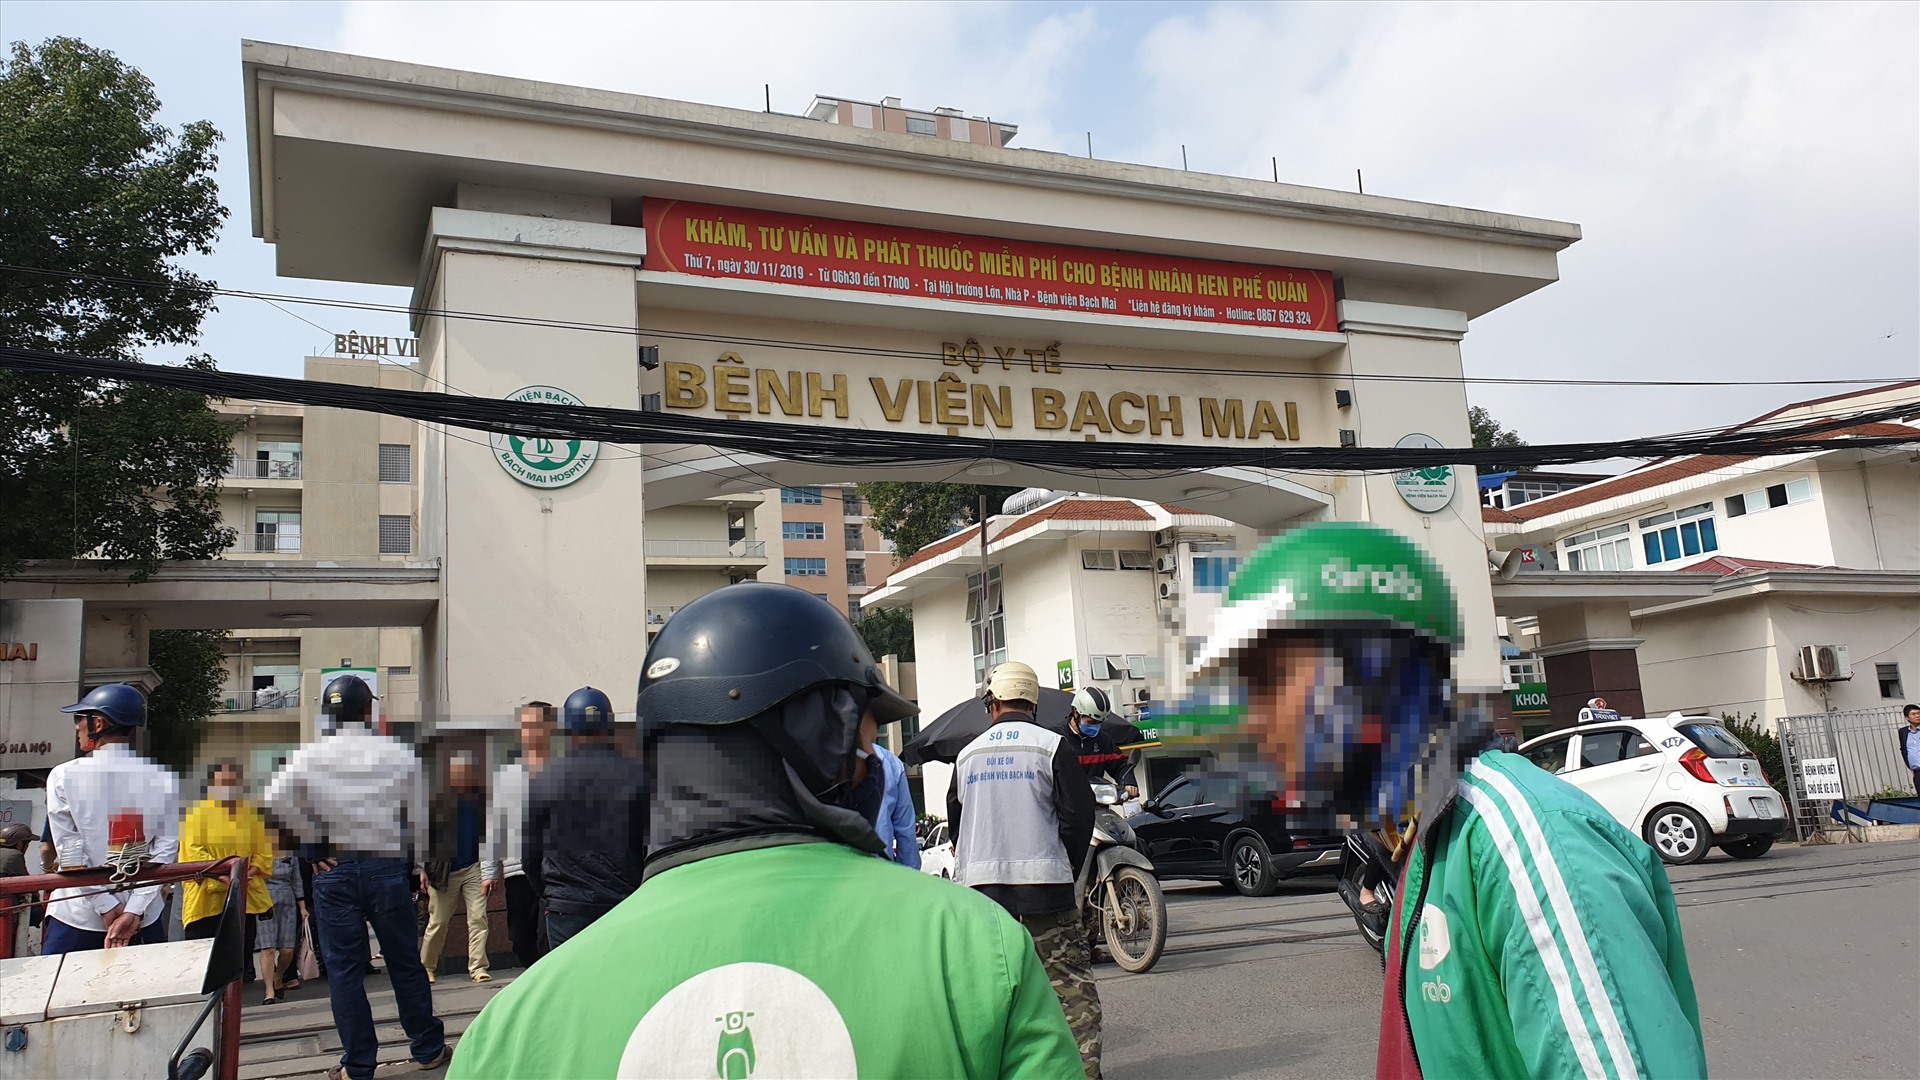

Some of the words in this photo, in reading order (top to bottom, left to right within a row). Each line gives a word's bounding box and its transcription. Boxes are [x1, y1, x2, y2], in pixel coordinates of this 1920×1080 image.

[685, 216, 753, 251] KHÁM,
[758, 226, 785, 252] TƯ
[788, 224, 828, 257] VẤN
[833, 231, 859, 260] VÀ
[863, 237, 911, 266] PHÁT
[916, 240, 974, 273] THUỐC
[979, 246, 1025, 278] MIỄN
[1029, 255, 1058, 281] PHÍ
[1062, 260, 1096, 285] CHO
[1100, 261, 1144, 292] BỆNH
[1148, 267, 1193, 294] NHÂN
[1197, 273, 1229, 297] HEN
[1232, 271, 1263, 300] PHẾ
[1266, 273, 1308, 303] QUẢN
[684, 252, 703, 268] Thứ
[718, 258, 741, 274] ngày
[780, 264, 804, 279] 2019
[818, 268, 830, 283] Từ
[832, 269, 861, 285] 06h30
[863, 271, 880, 287] đến
[882, 275, 910, 290] 17h00
[923, 279, 938, 295] Tại
[939, 280, 954, 297] Hội
[956, 282, 983, 299] trường
[985, 285, 1003, 300] Lớn,
[1005, 287, 1022, 301] Nhà
[1023, 289, 1030, 302] P
[1037, 290, 1058, 306] Bệnh
[1060, 293, 1077, 309] viện
[1079, 294, 1100, 310] Bạch
[1101, 297, 1117, 310] Mai
[1150, 301, 1160, 316] hệ
[1162, 302, 1181, 317] đăng
[1182, 303, 1192, 318] ký
[1193, 304, 1215, 318] khám
[1226, 307, 1255, 321] Hotline:
[1257, 308, 1276, 322] 0867
[1279, 309, 1294, 324] 629
[1296, 311, 1311, 325] 324
[335, 330, 388, 359] BỆNH
[942, 338, 986, 374] BỘ
[994, 346, 1016, 371] Y
[1024, 341, 1062, 374] TẾ
[664, 351, 849, 421] BỆNH
[868, 371, 1013, 437] VIỆN
[1032, 386, 1184, 442] BẠCH
[1199, 397, 1300, 441] MAI
[501, 452, 526, 476] BACH
[526, 472, 547, 483] MAI
[550, 452, 591, 483] HOSPITAL
[1059, 668, 1072, 684] K3
[1516, 693, 1548, 706] KHOA
[989, 728, 1004, 741] SỐ
[1006, 730, 1019, 740] 90
[997, 757, 1004, 765] XE
